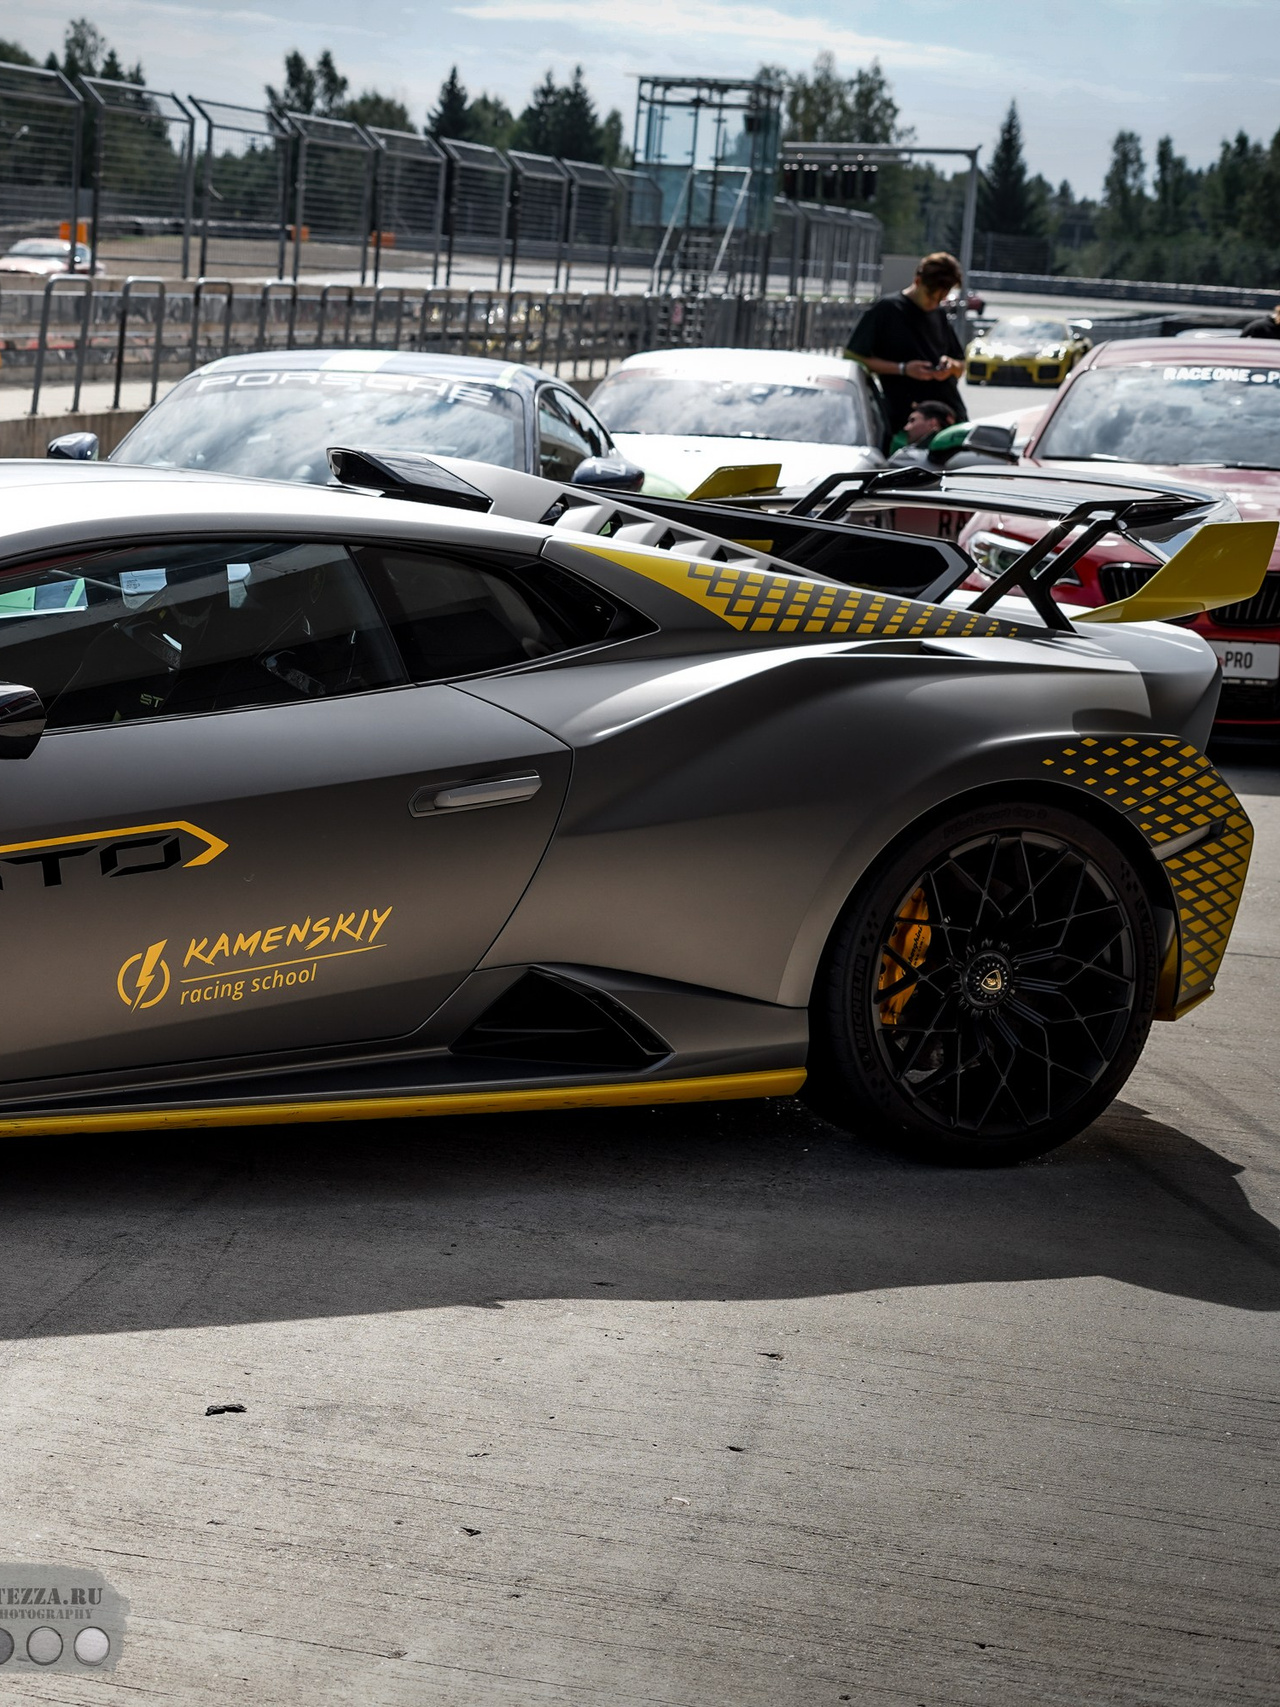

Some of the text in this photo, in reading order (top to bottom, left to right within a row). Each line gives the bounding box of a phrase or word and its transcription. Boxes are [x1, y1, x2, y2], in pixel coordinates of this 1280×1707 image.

[196, 372, 494, 406] PORSCHE
[1225, 651, 1253, 669] PRO
[139, 693, 165, 709] ST
[182, 906, 393, 969] KAMENSKIY
[180, 963, 317, 1006] racing school
[1141, 921, 1156, 1012] MICHELIN
[851, 954, 869, 1049] MICHELIN
